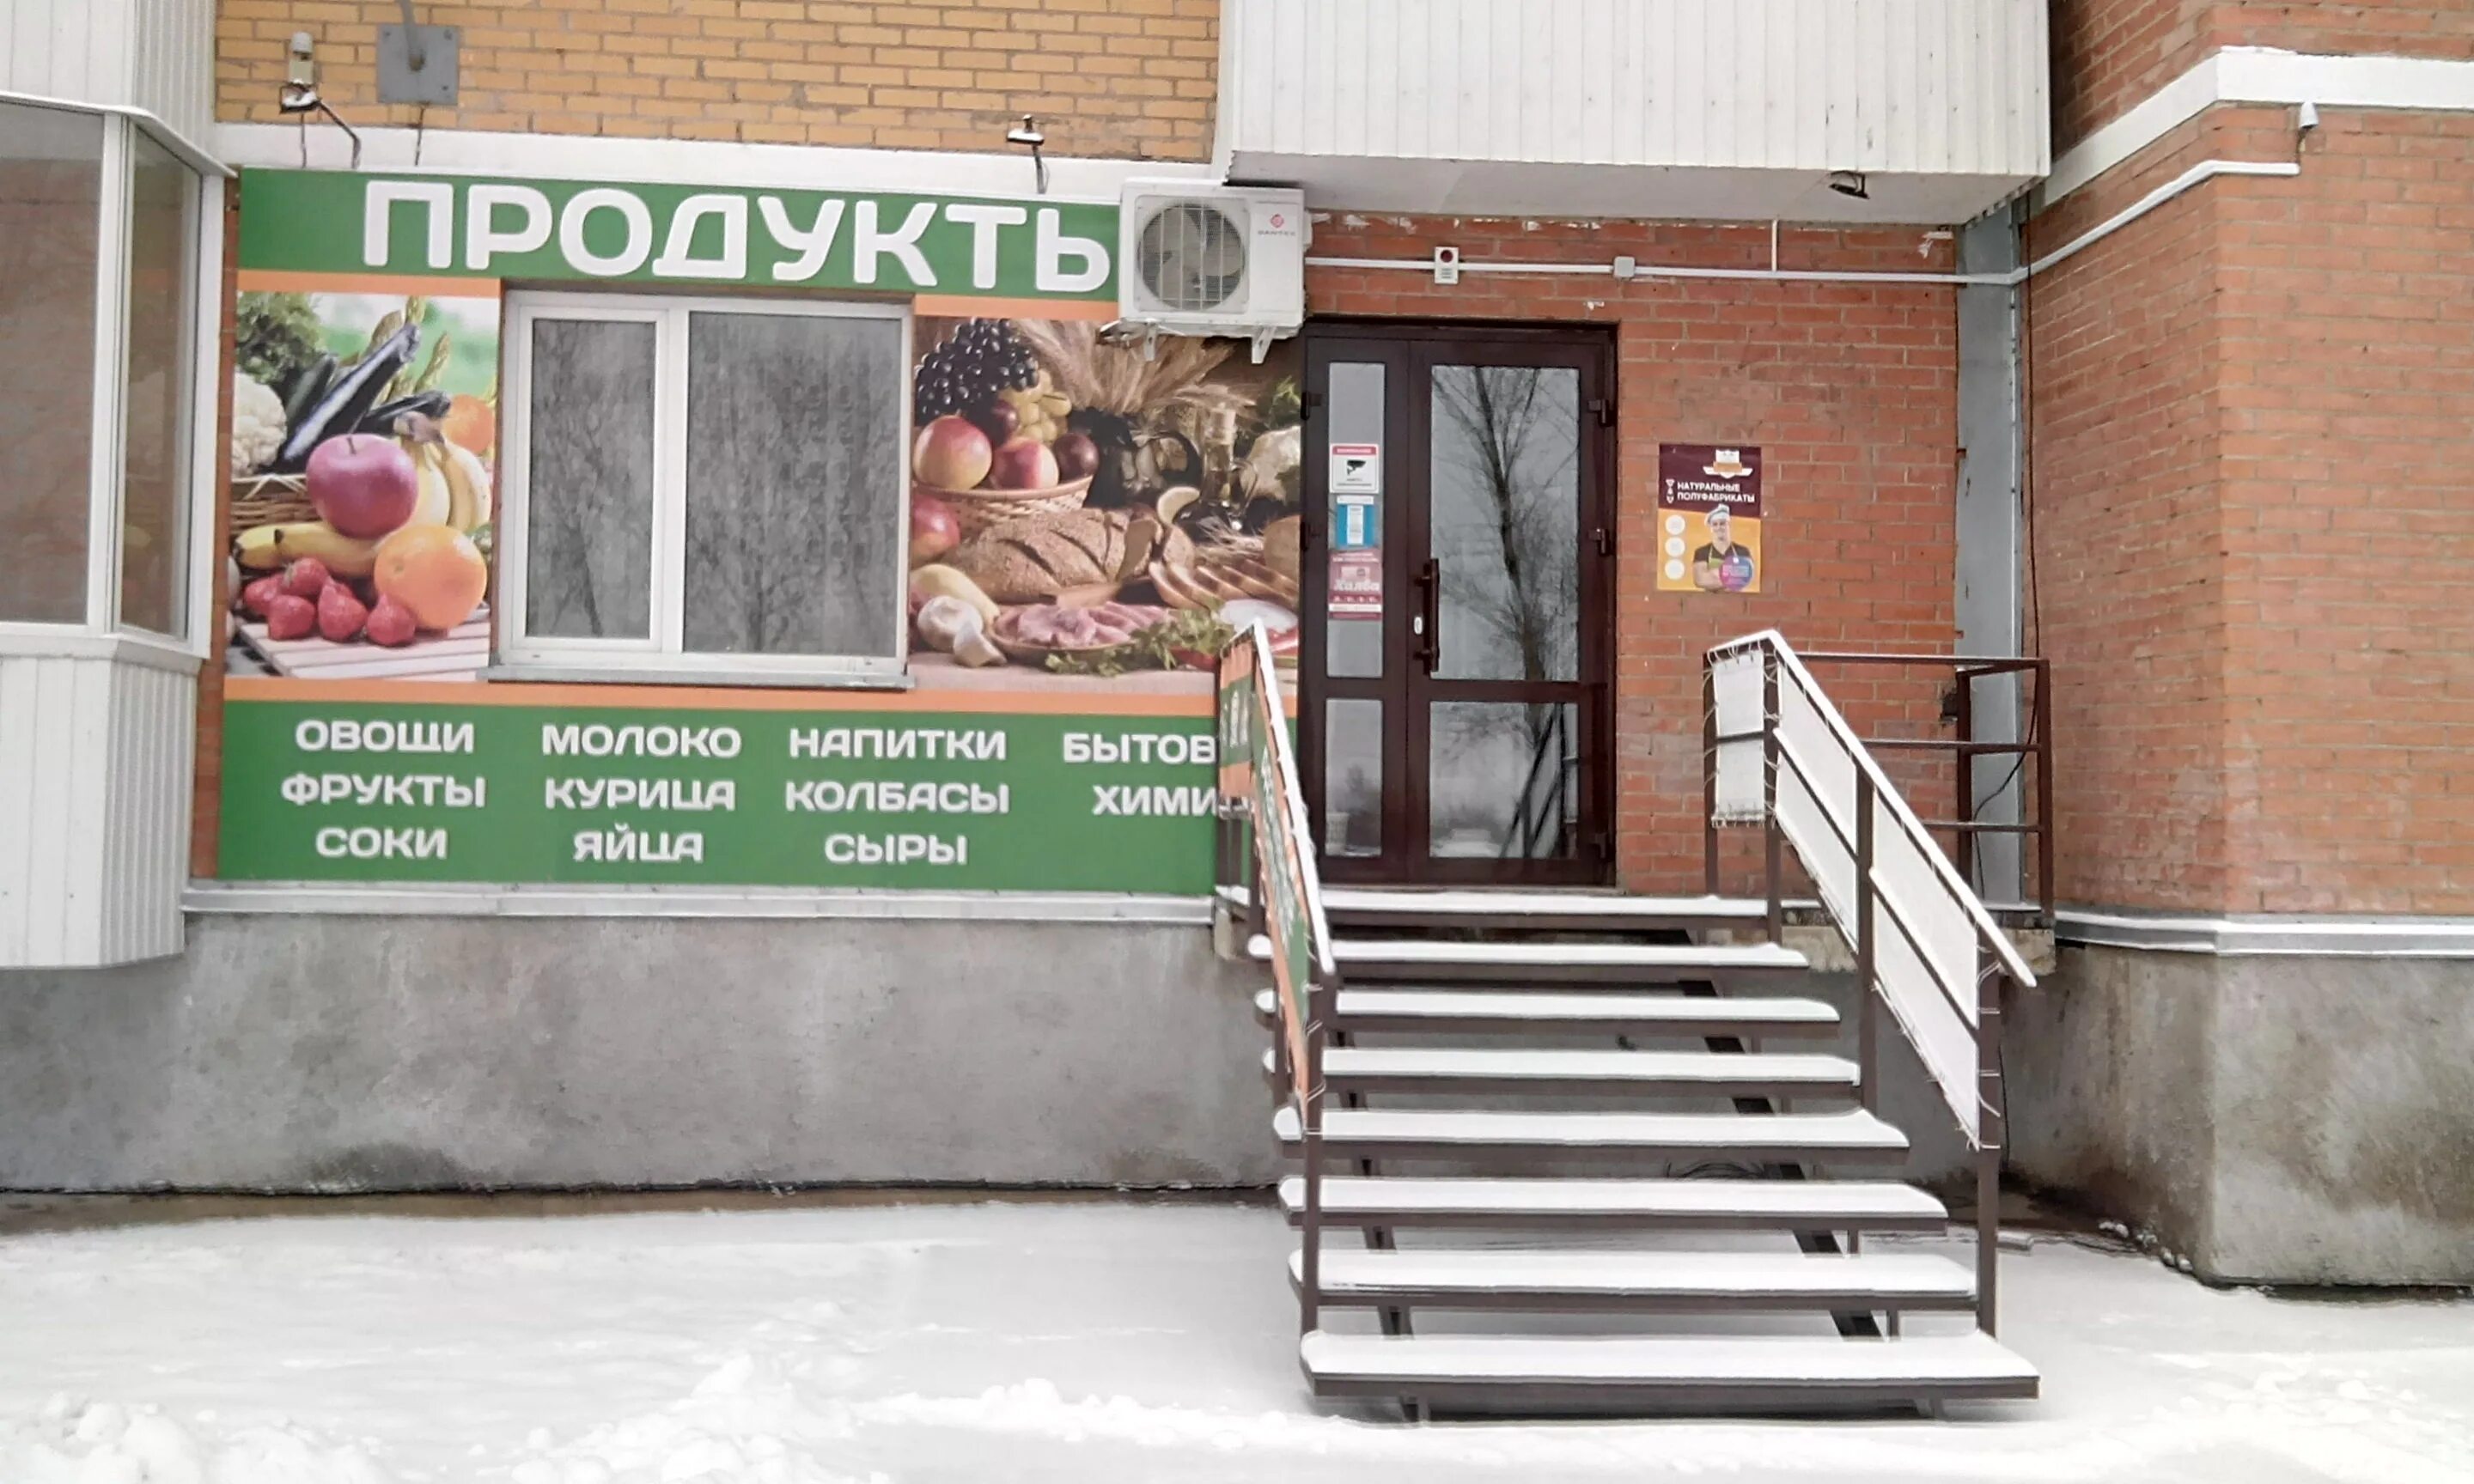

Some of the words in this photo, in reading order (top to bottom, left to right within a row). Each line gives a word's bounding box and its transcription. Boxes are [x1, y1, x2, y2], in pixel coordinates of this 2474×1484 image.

[1677, 482, 1740, 492] НАТУРАЛЬНЫЕ
[1677, 492, 1755, 502] ПОЛУФАБРИКАТЫ
[296, 720, 476, 756] ОВОЩИ
[542, 723, 743, 760] МОЛОКО
[789, 726, 1008, 762] НАПИТКИ
[281, 772, 487, 809] ФРУКТЫ
[545, 776, 737, 812] КУРИЦА
[785, 779, 1010, 815] КОЛБАСЫ
[316, 826, 449, 861] СОКИ
[573, 822, 705, 865] ЯЙЦА
[824, 832, 969, 867] СЫРЫ
